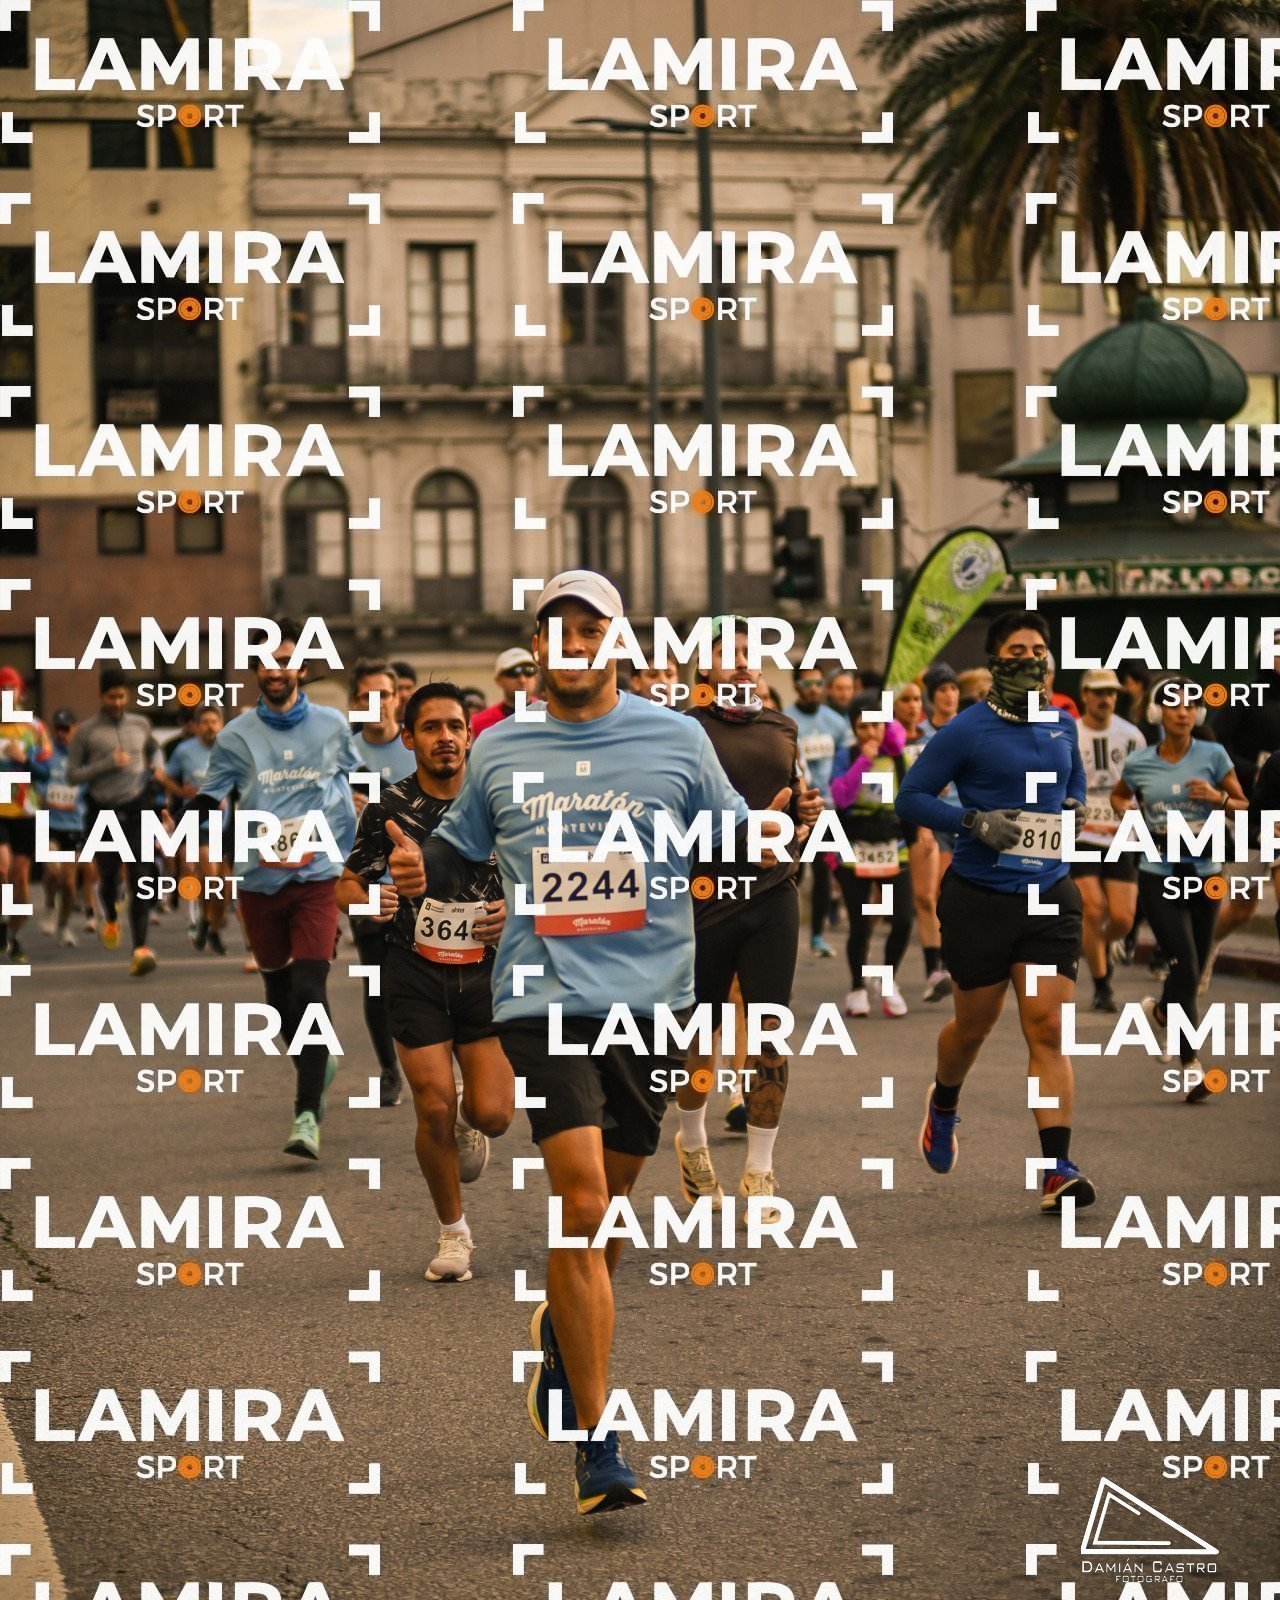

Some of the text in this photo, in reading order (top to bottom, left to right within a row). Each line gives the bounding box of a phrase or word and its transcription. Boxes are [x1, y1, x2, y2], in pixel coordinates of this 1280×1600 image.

[258, 767, 321, 786] Maratón
[522, 790, 645, 821] Maratón
[542, 869, 639, 903] 2244
